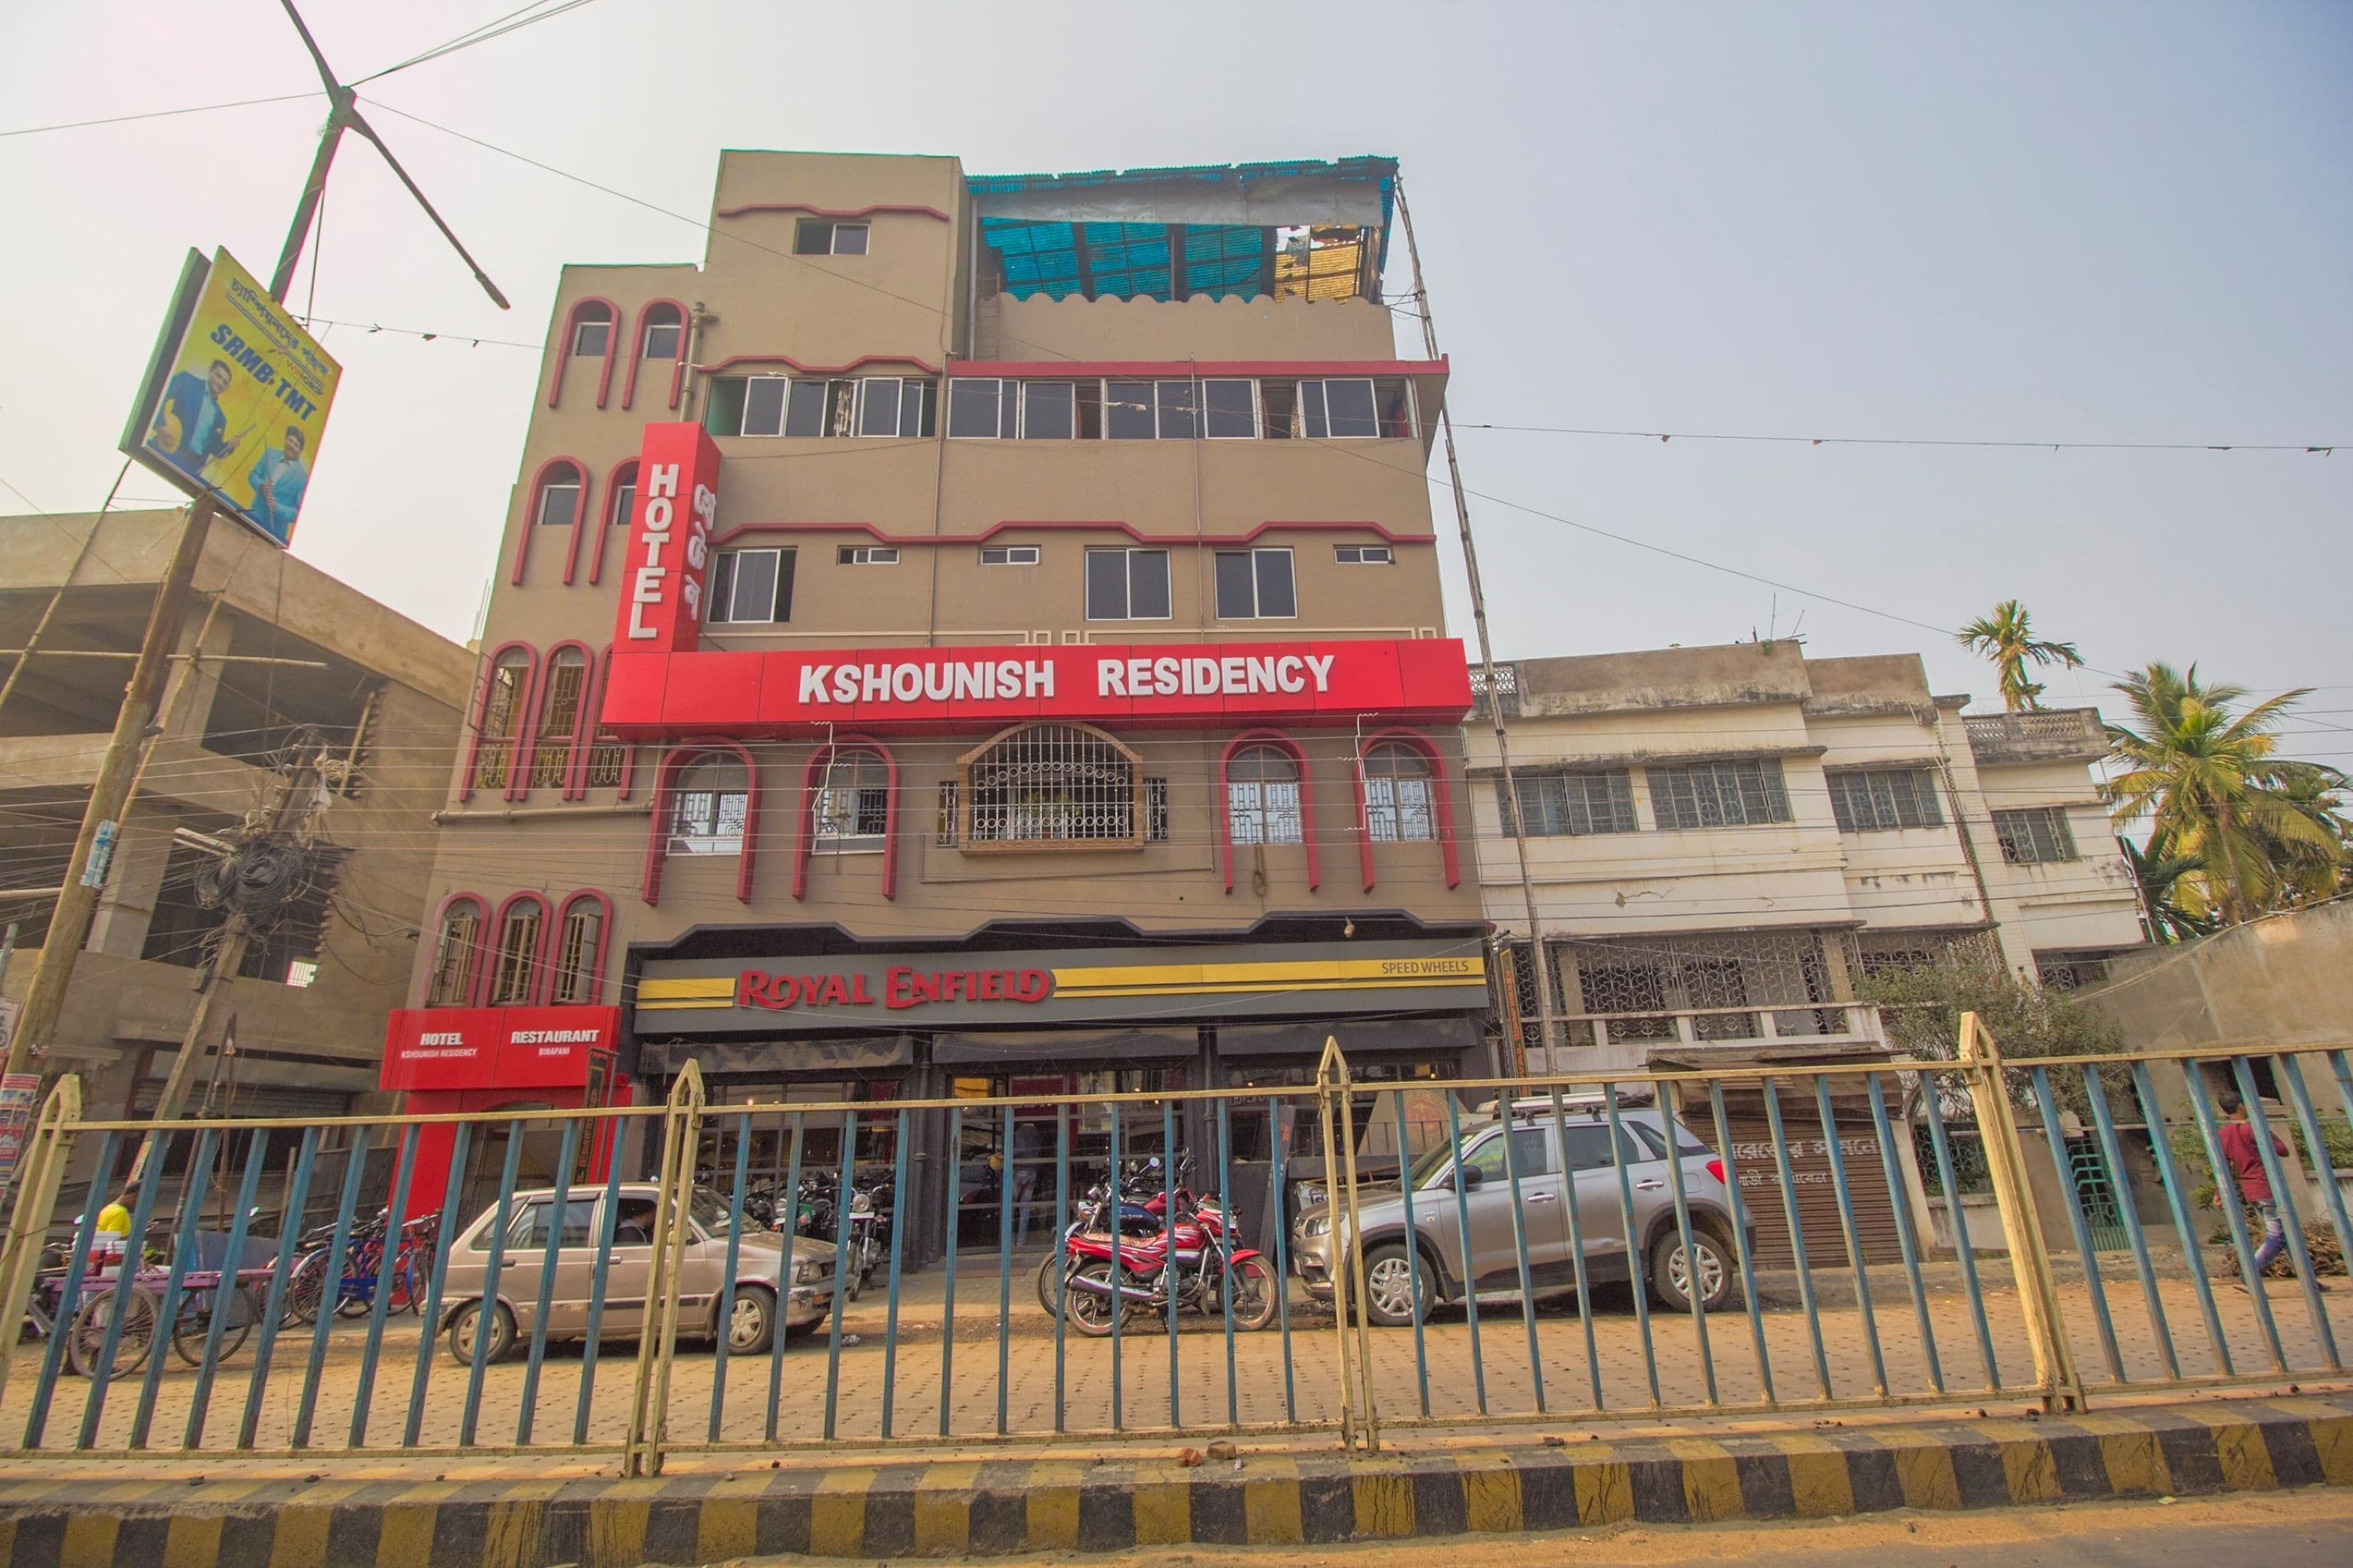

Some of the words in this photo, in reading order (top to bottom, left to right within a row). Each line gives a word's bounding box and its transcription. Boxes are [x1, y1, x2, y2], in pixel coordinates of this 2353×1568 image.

[210, 324, 276, 384] SRMB
[275, 377, 318, 422] TMT
[628, 464, 679, 639] HOTEL
[799, 660, 1055, 704] KSHOUNISH
[1098, 654, 1334, 697] RESIDENCY
[1382, 961, 1419, 974] SPEED
[1421, 960, 1469, 973] WHEELS
[739, 970, 874, 1009] ROYAL
[885, 967, 1051, 1009] ENFIELD
[420, 1032, 464, 1046] HOTEL
[511, 1029, 600, 1045] RESTAURANT
[401, 1050, 439, 1059] KSHOUNISH
[439, 1048, 478, 1058] RESIDENCY
[538, 1047, 570, 1056] BINAPANI
